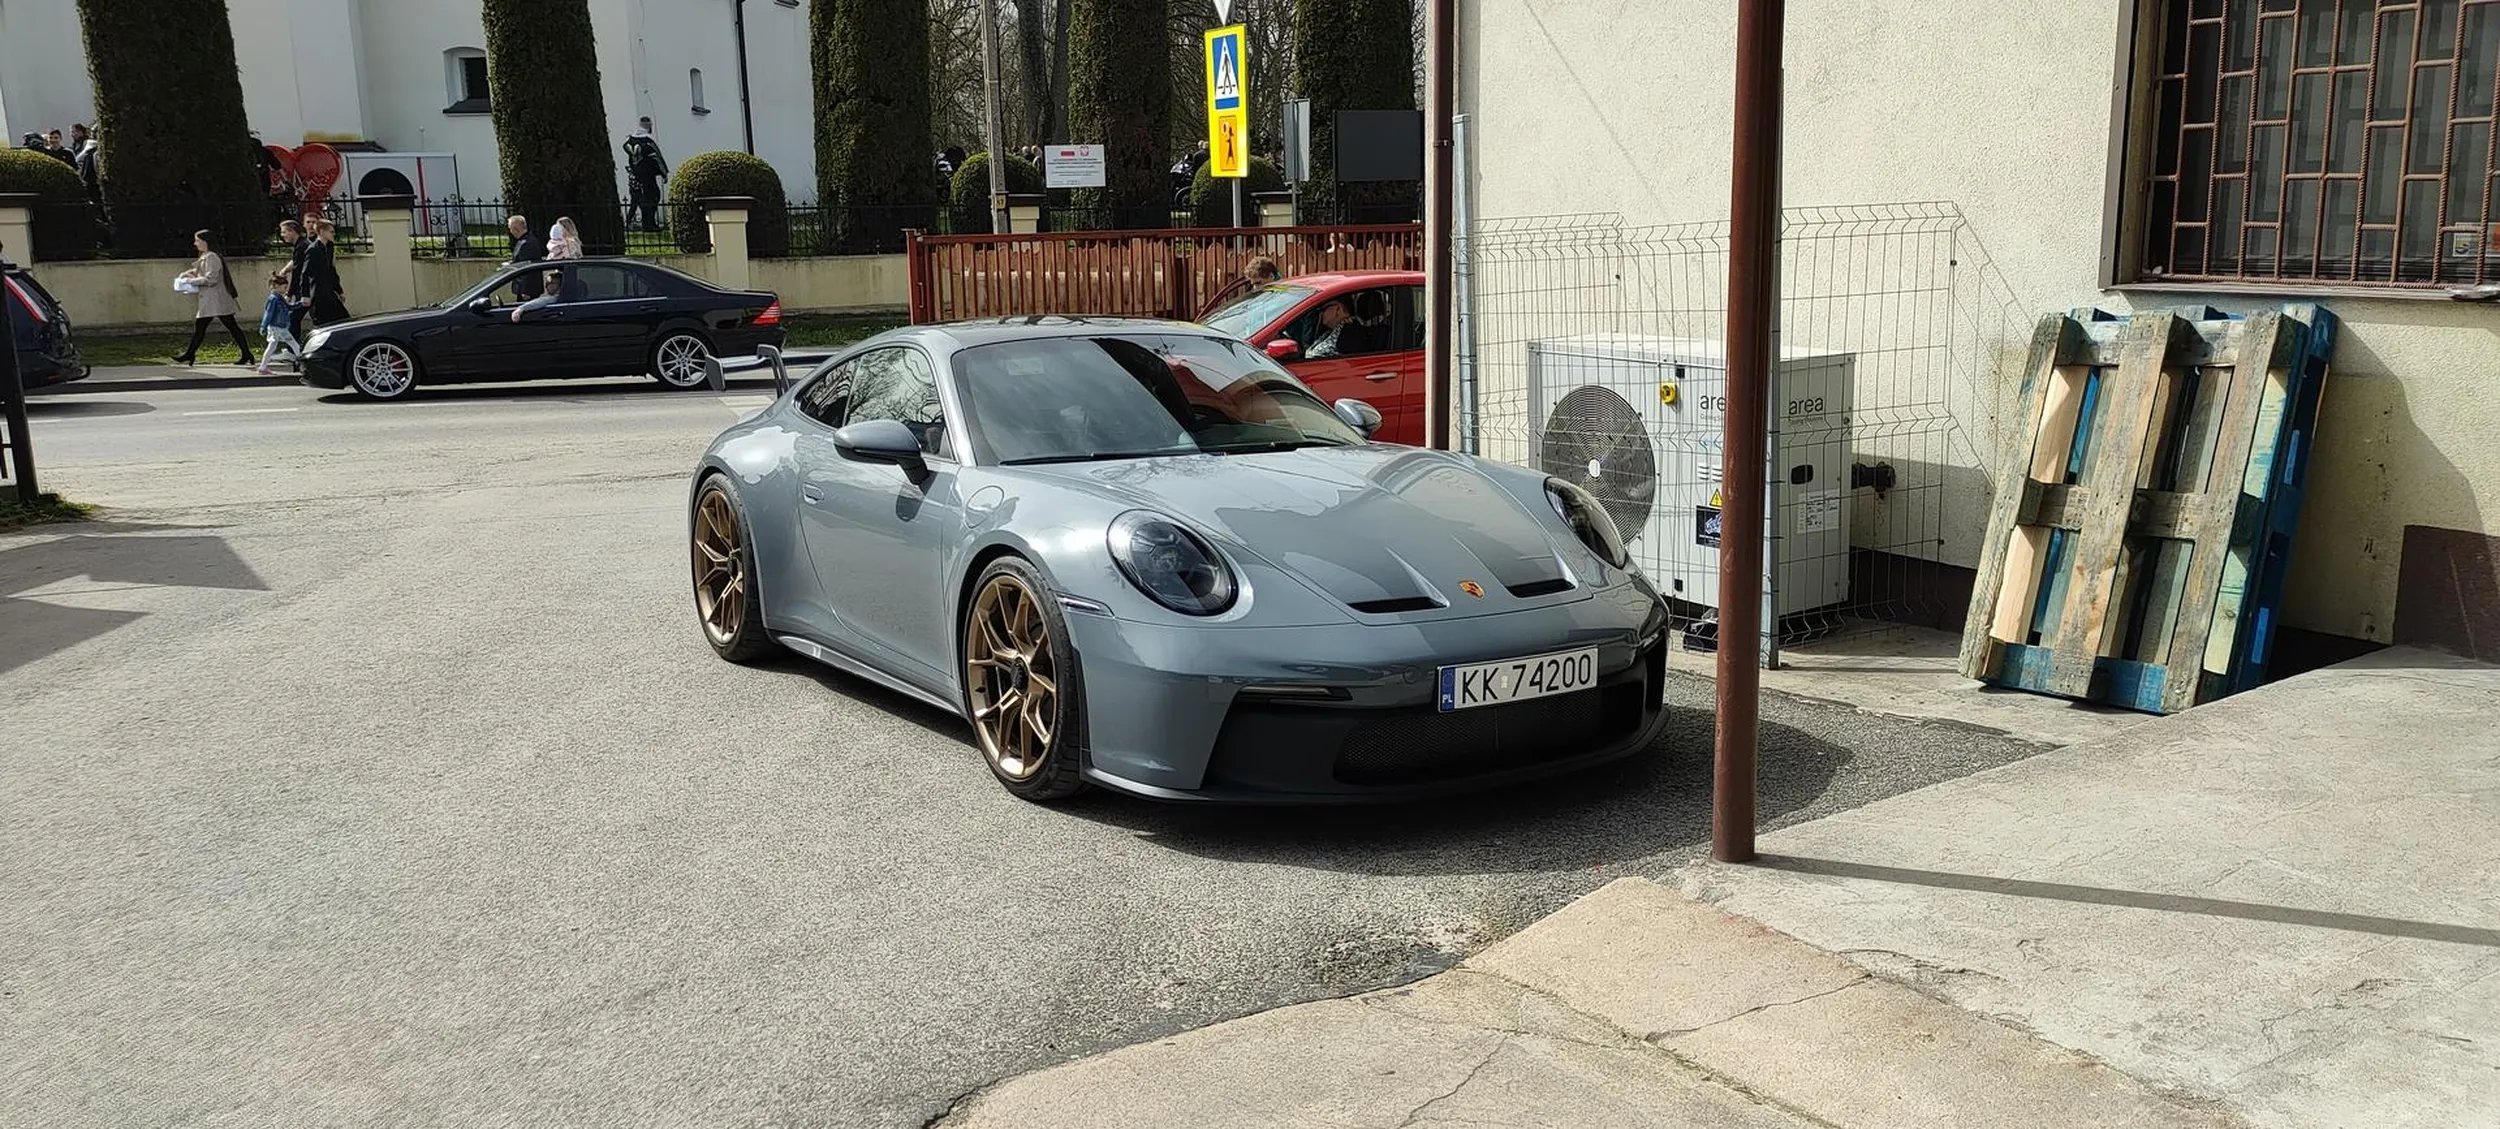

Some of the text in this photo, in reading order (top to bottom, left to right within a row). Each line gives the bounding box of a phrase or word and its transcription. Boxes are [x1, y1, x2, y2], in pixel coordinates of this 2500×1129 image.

[1700, 395, 1726, 411] are
[1788, 397, 1823, 415] area
[1462, 654, 1591, 704] KK 74200
[1442, 694, 1453, 704] PL
